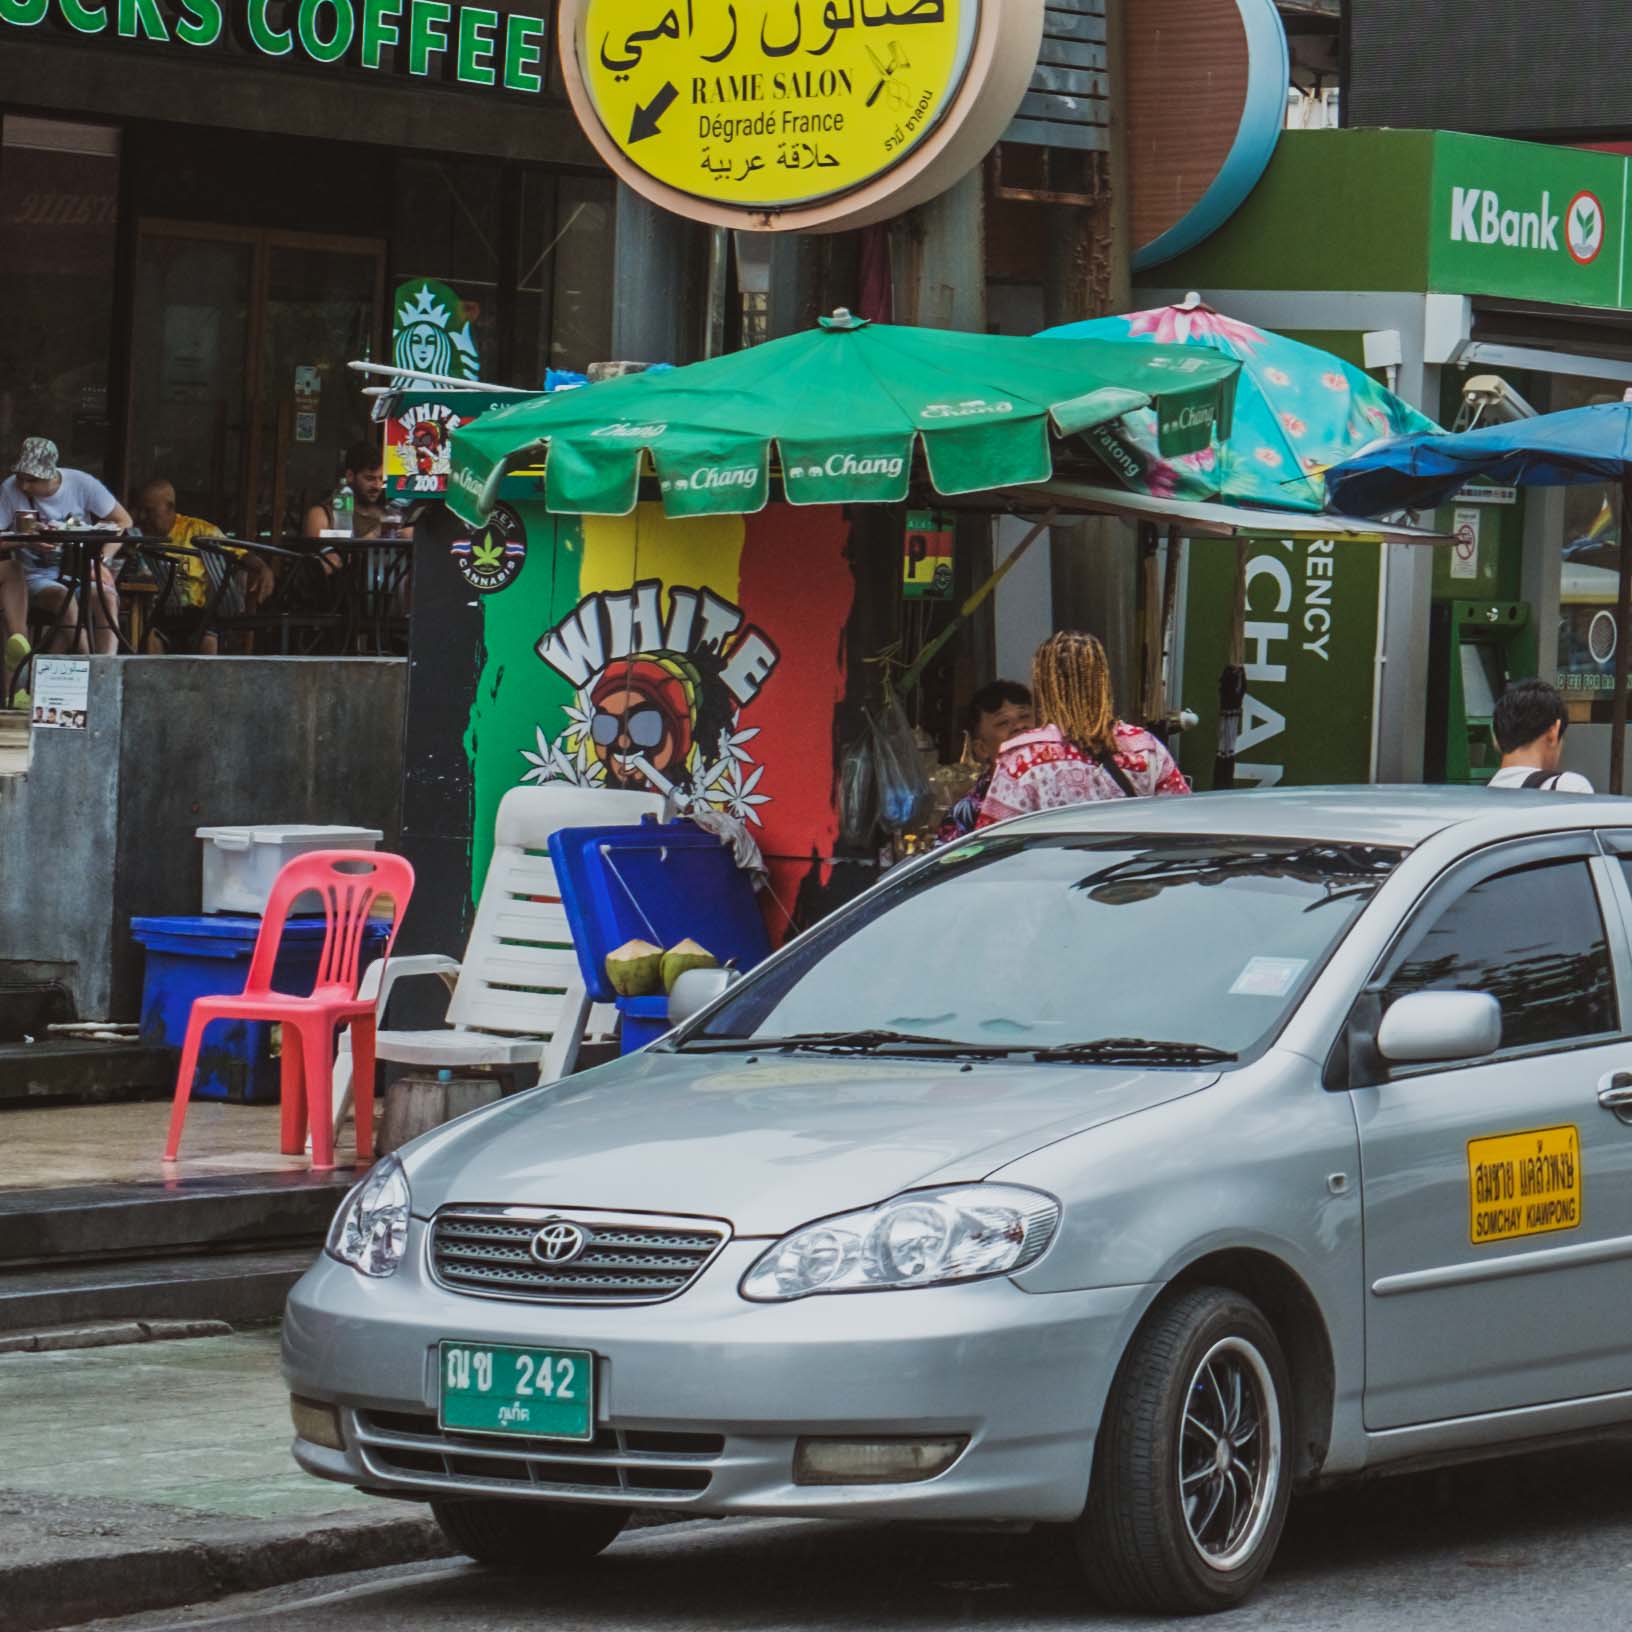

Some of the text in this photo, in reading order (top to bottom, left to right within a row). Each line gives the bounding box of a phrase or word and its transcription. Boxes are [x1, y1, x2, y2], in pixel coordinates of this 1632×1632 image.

[691, 69, 854, 105] RAME SALON
[699, 109, 844, 143] Dégradé France
[700, 141, 841, 182] حلاقة عربية
[1450, 186, 1560, 252] KBank
[1179, 404, 1216, 431] Chang
[690, 465, 759, 490] Chang
[825, 453, 904, 478] Chang
[458, 557, 517, 588] CANNABIS
[535, 579, 781, 707] WHITE
[1475, 1161, 1515, 1205] สมชาย
[1476, 1205, 1522, 1237] SOMCHAY
[515, 1354, 576, 1399] 242
